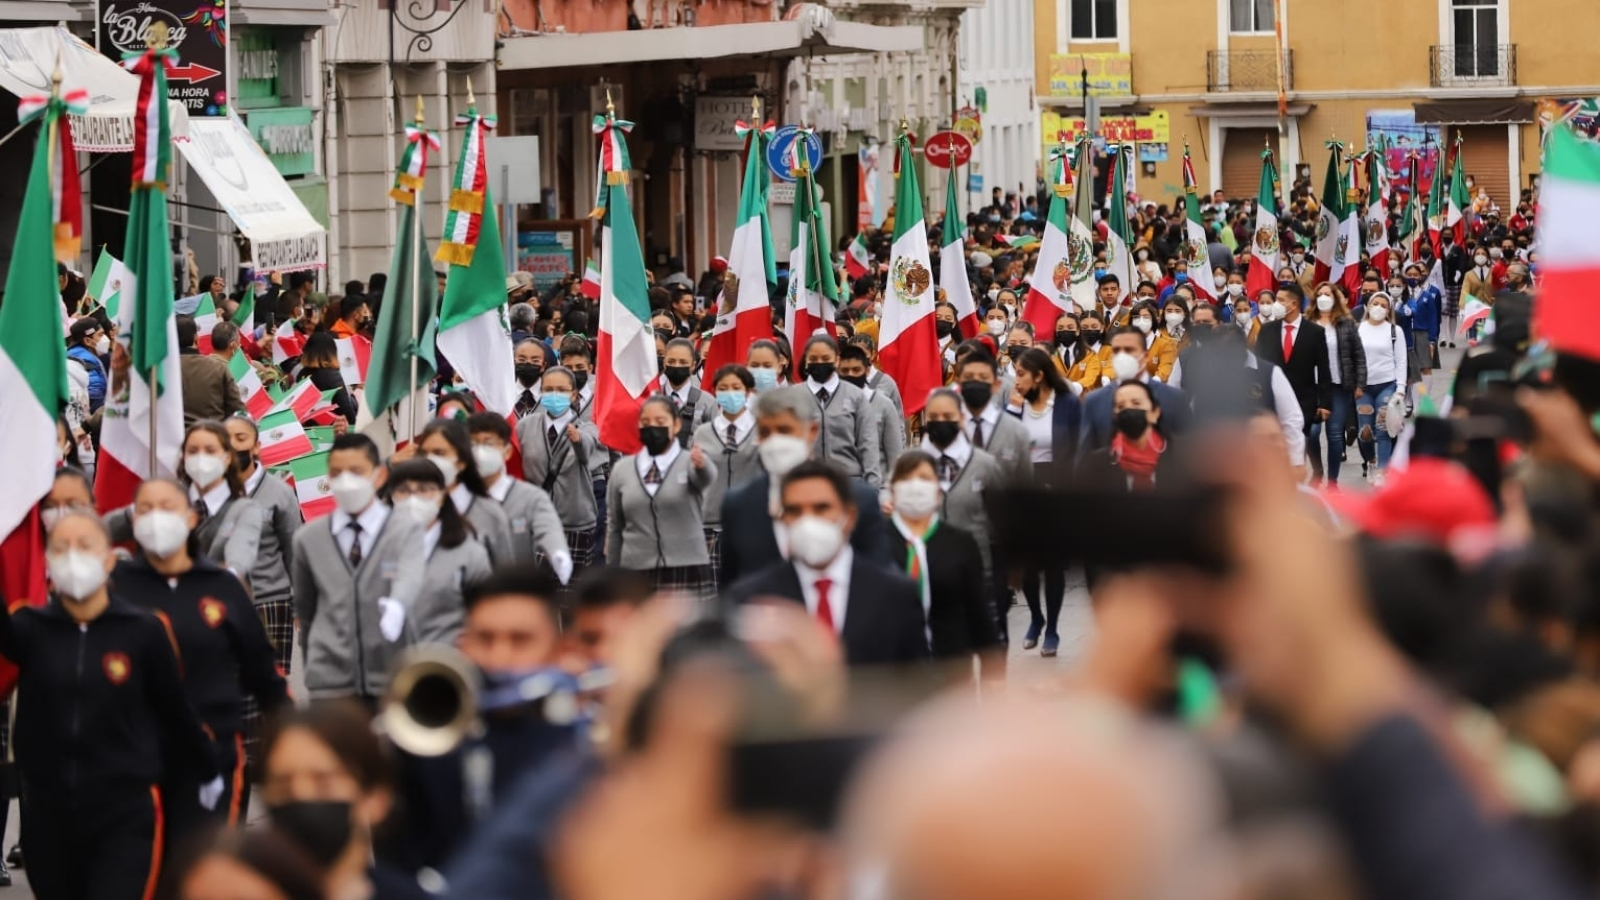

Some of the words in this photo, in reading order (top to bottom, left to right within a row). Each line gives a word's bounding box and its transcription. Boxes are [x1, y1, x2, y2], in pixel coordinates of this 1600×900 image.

[110, 15, 187, 45] Blaca
[167, 88, 180, 97] NA
[181, 88, 210, 97] HORA
[182, 99, 205, 109] ATIS
[702, 101, 755, 114] HOTE
